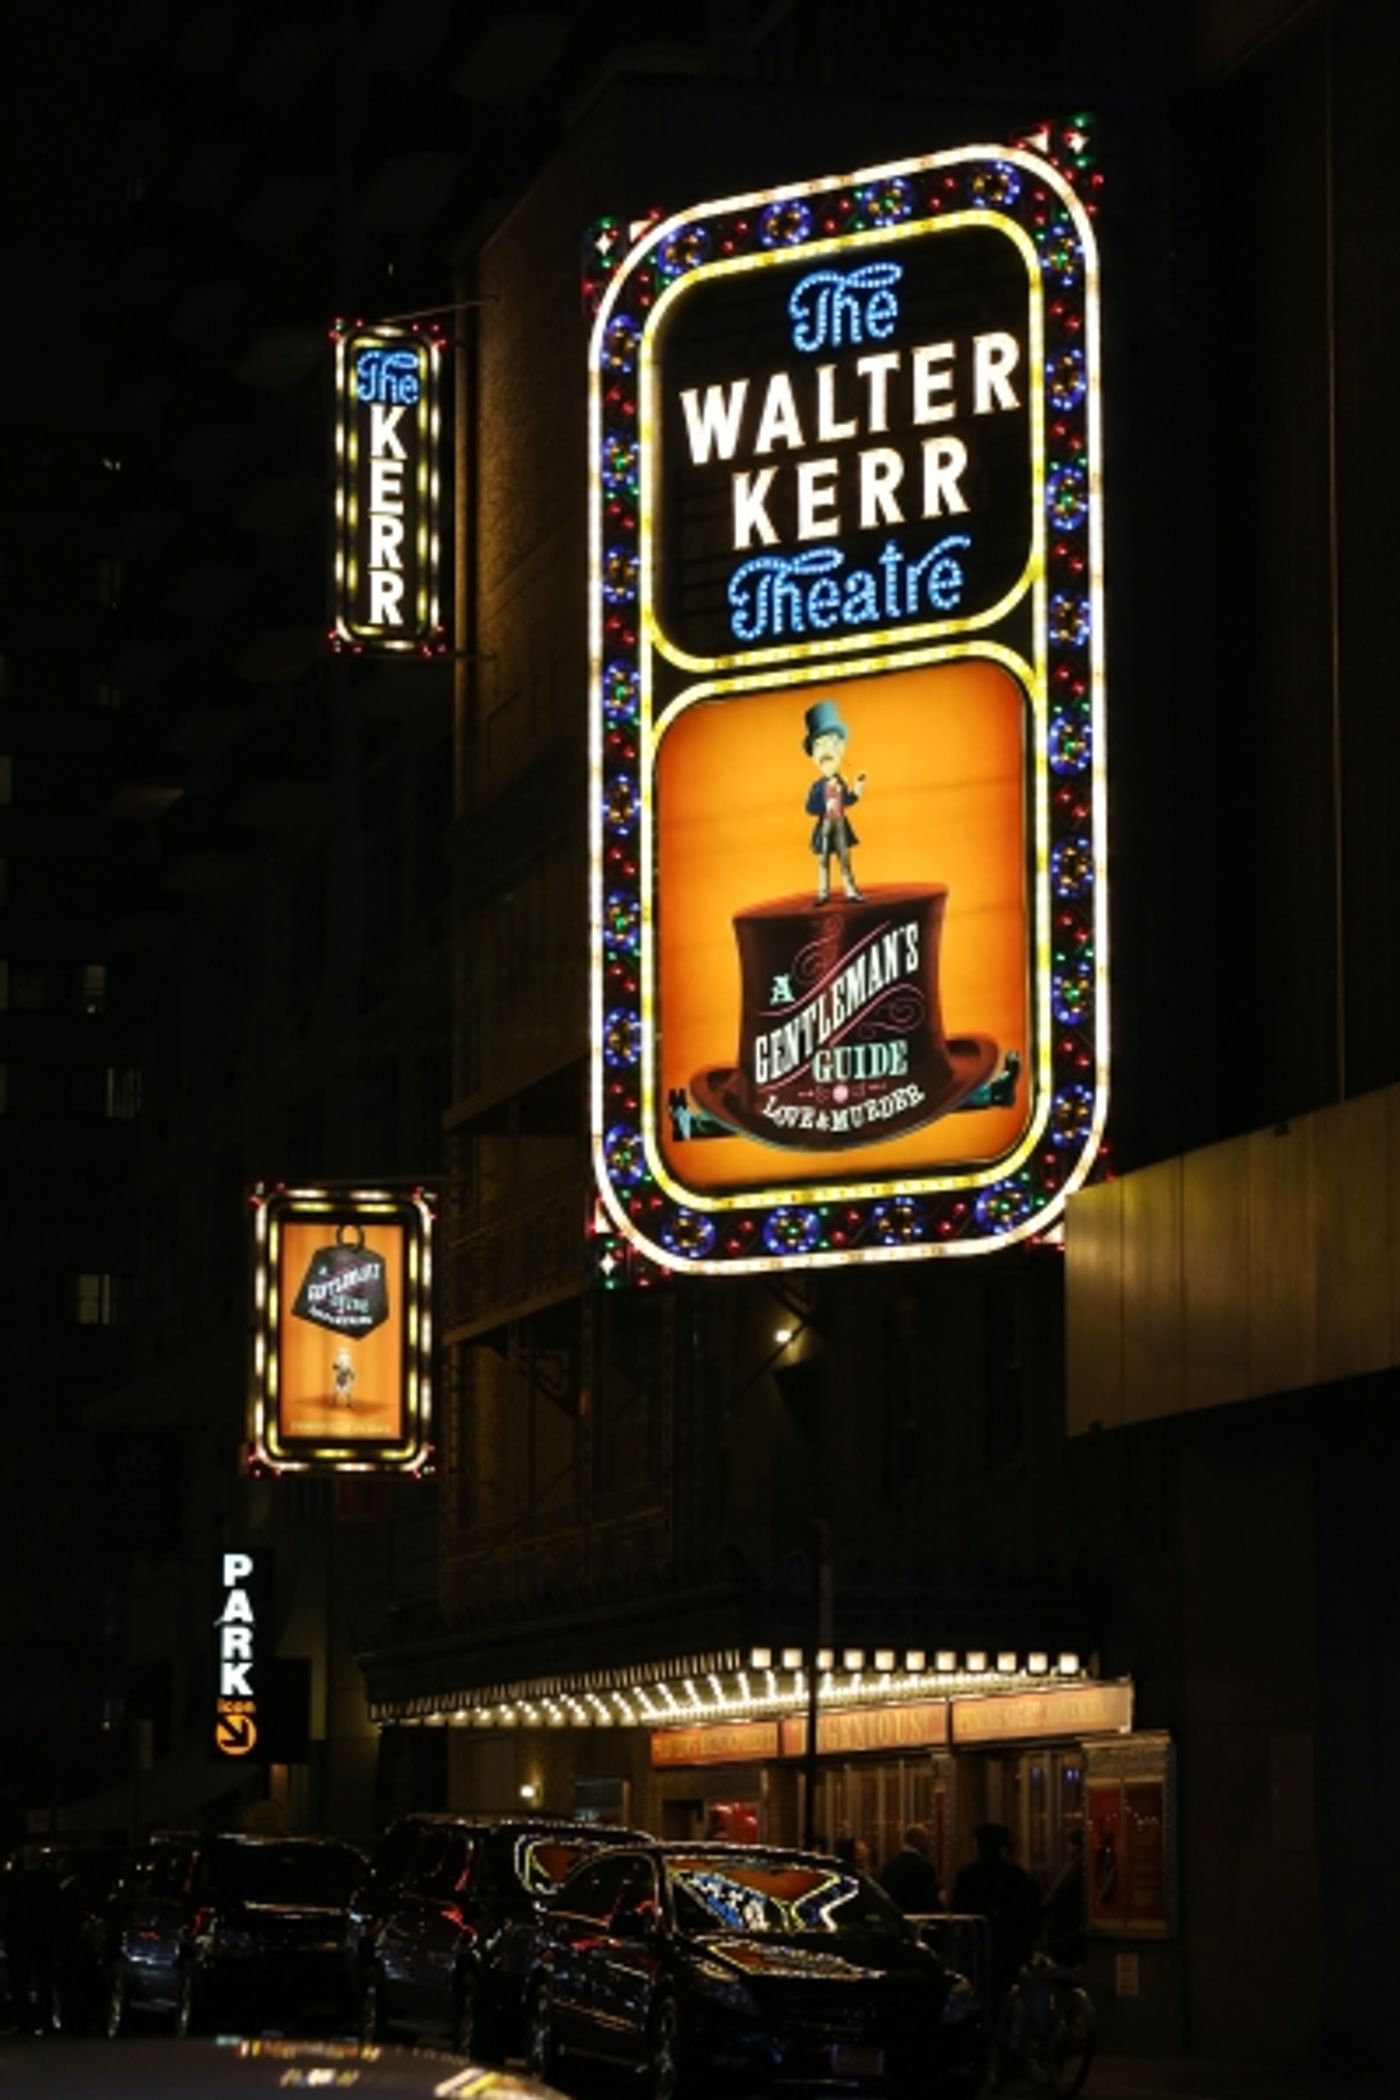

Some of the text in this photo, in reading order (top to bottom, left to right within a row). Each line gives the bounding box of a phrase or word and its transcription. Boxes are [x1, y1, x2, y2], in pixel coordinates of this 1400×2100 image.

[789, 262, 903, 352] The
[356, 350, 419, 405] The
[679, 331, 1021, 466] WALTER
[369, 403, 408, 626] KERR
[732, 436, 970, 551] KERR
[727, 534, 972, 641] Theatre
[755, 922, 919, 1084] GENTLEMAN'S
[770, 974, 795, 1005] A
[811, 1040, 908, 1083] GUIDE
[220, 1553, 254, 1696] PARK
